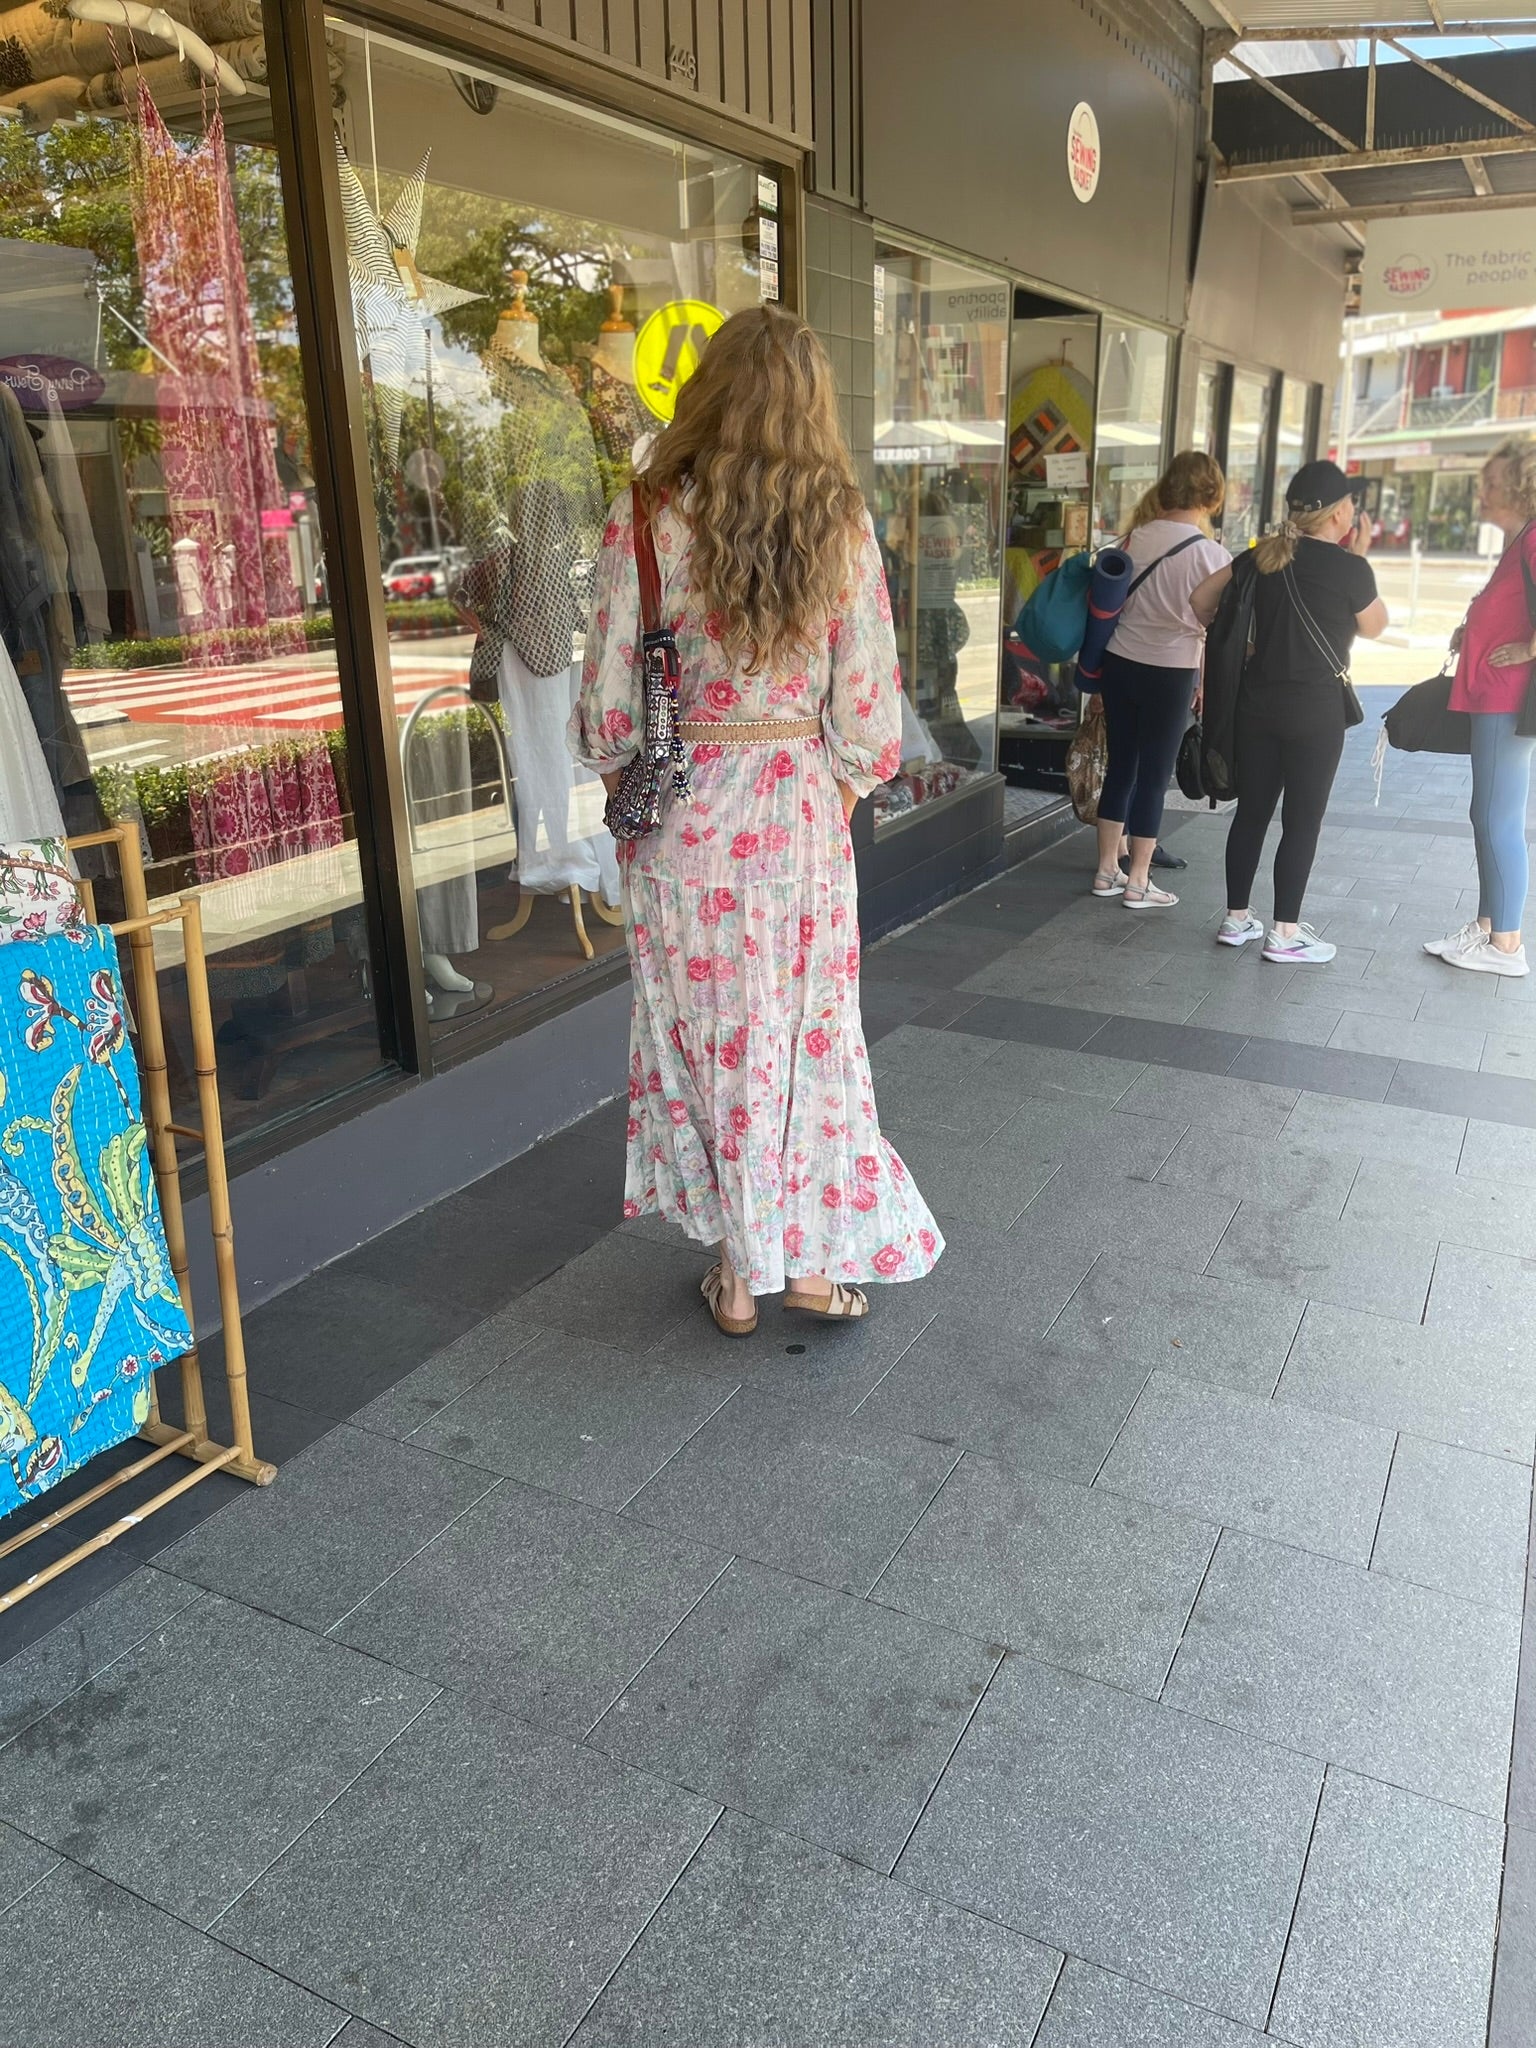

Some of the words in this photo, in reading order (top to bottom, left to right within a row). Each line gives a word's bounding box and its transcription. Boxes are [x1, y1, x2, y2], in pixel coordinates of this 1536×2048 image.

[1072, 135, 1097, 173] SEWING
[1446, 253, 1476, 267] The
[1482, 249, 1532, 265] fabric
[1383, 267, 1431, 284] SEWING
[1467, 266, 1528, 285] people
[918, 535, 963, 549] SEWING
